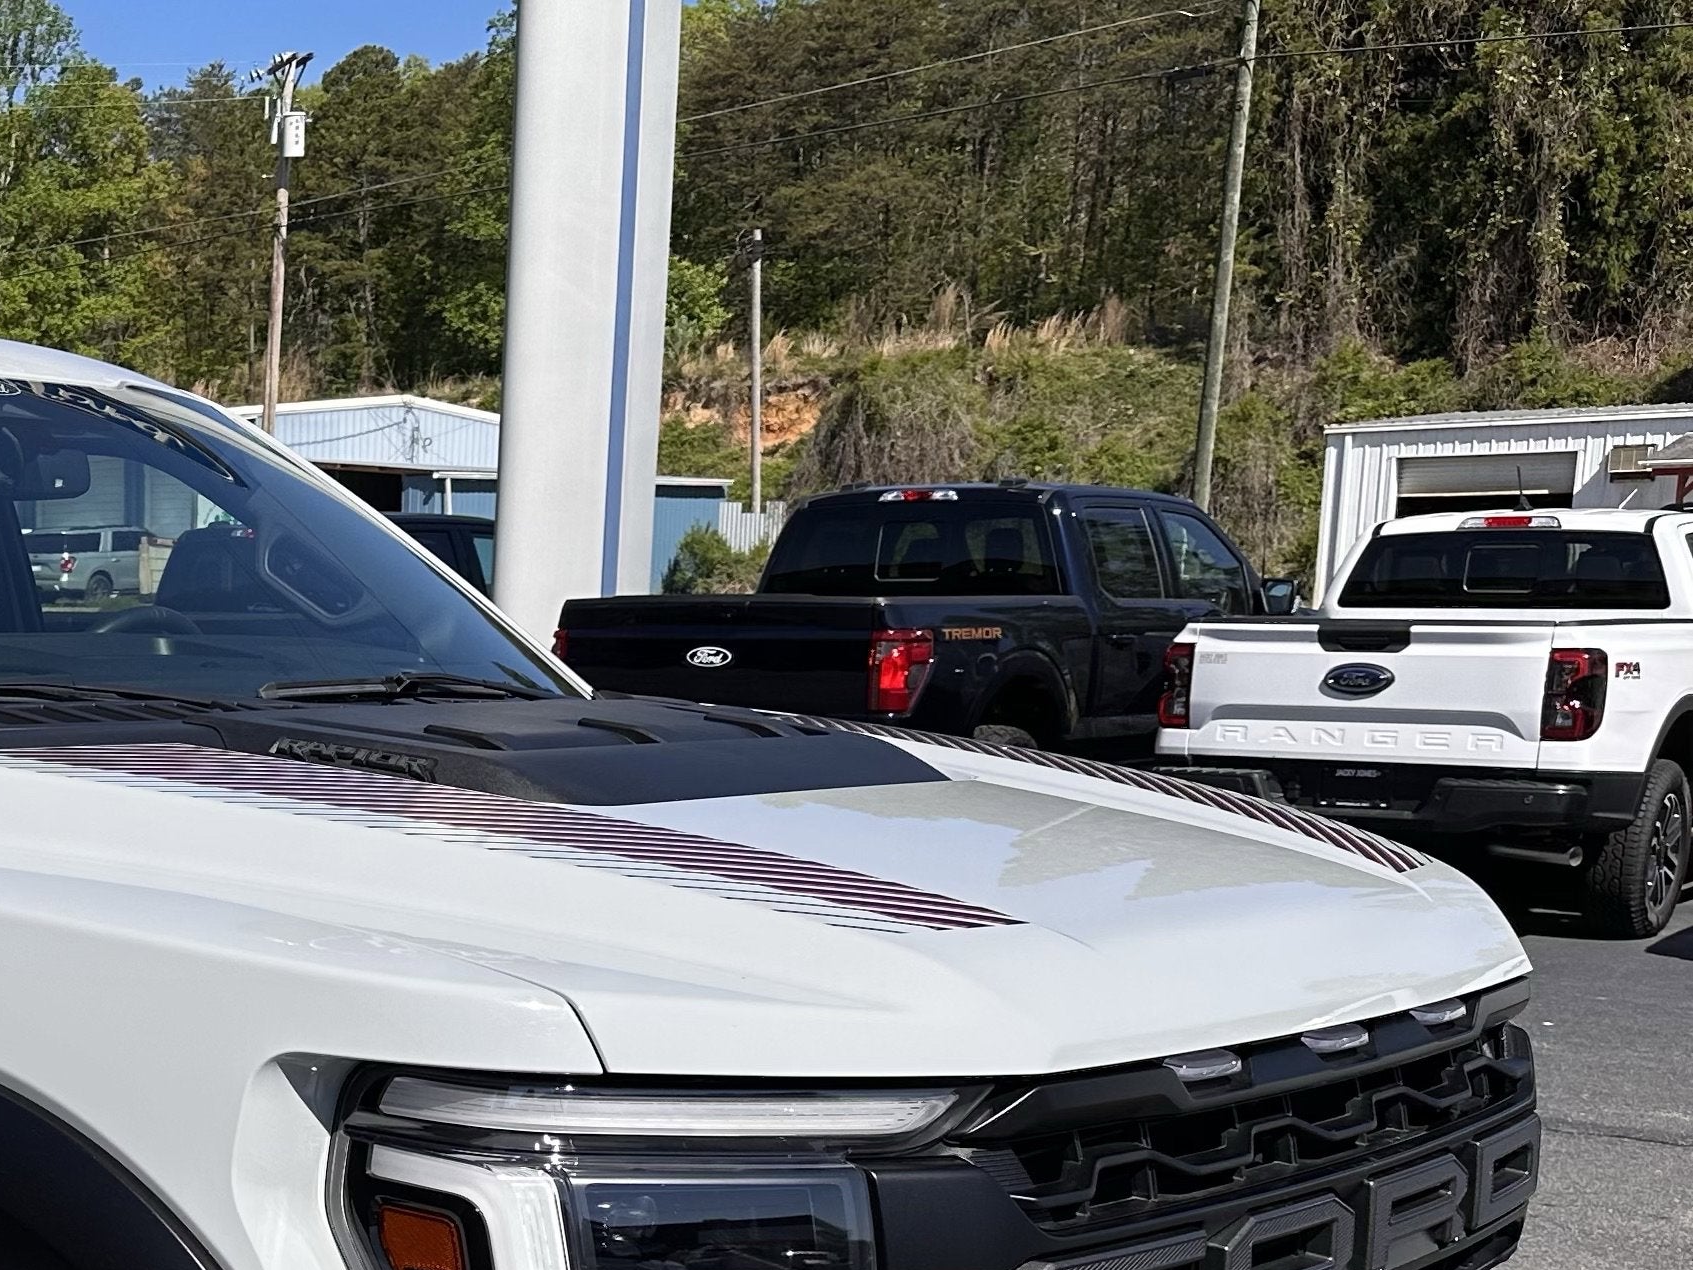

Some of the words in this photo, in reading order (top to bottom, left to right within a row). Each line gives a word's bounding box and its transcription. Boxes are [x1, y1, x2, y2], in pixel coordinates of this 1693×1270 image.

[941, 626, 1003, 641] TREMOR
[693, 649, 724, 664] Ford
[1615, 661, 1641, 678] FX4
[1215, 723, 1505, 752] RANGER
[269, 736, 439, 783] RAPTOR
